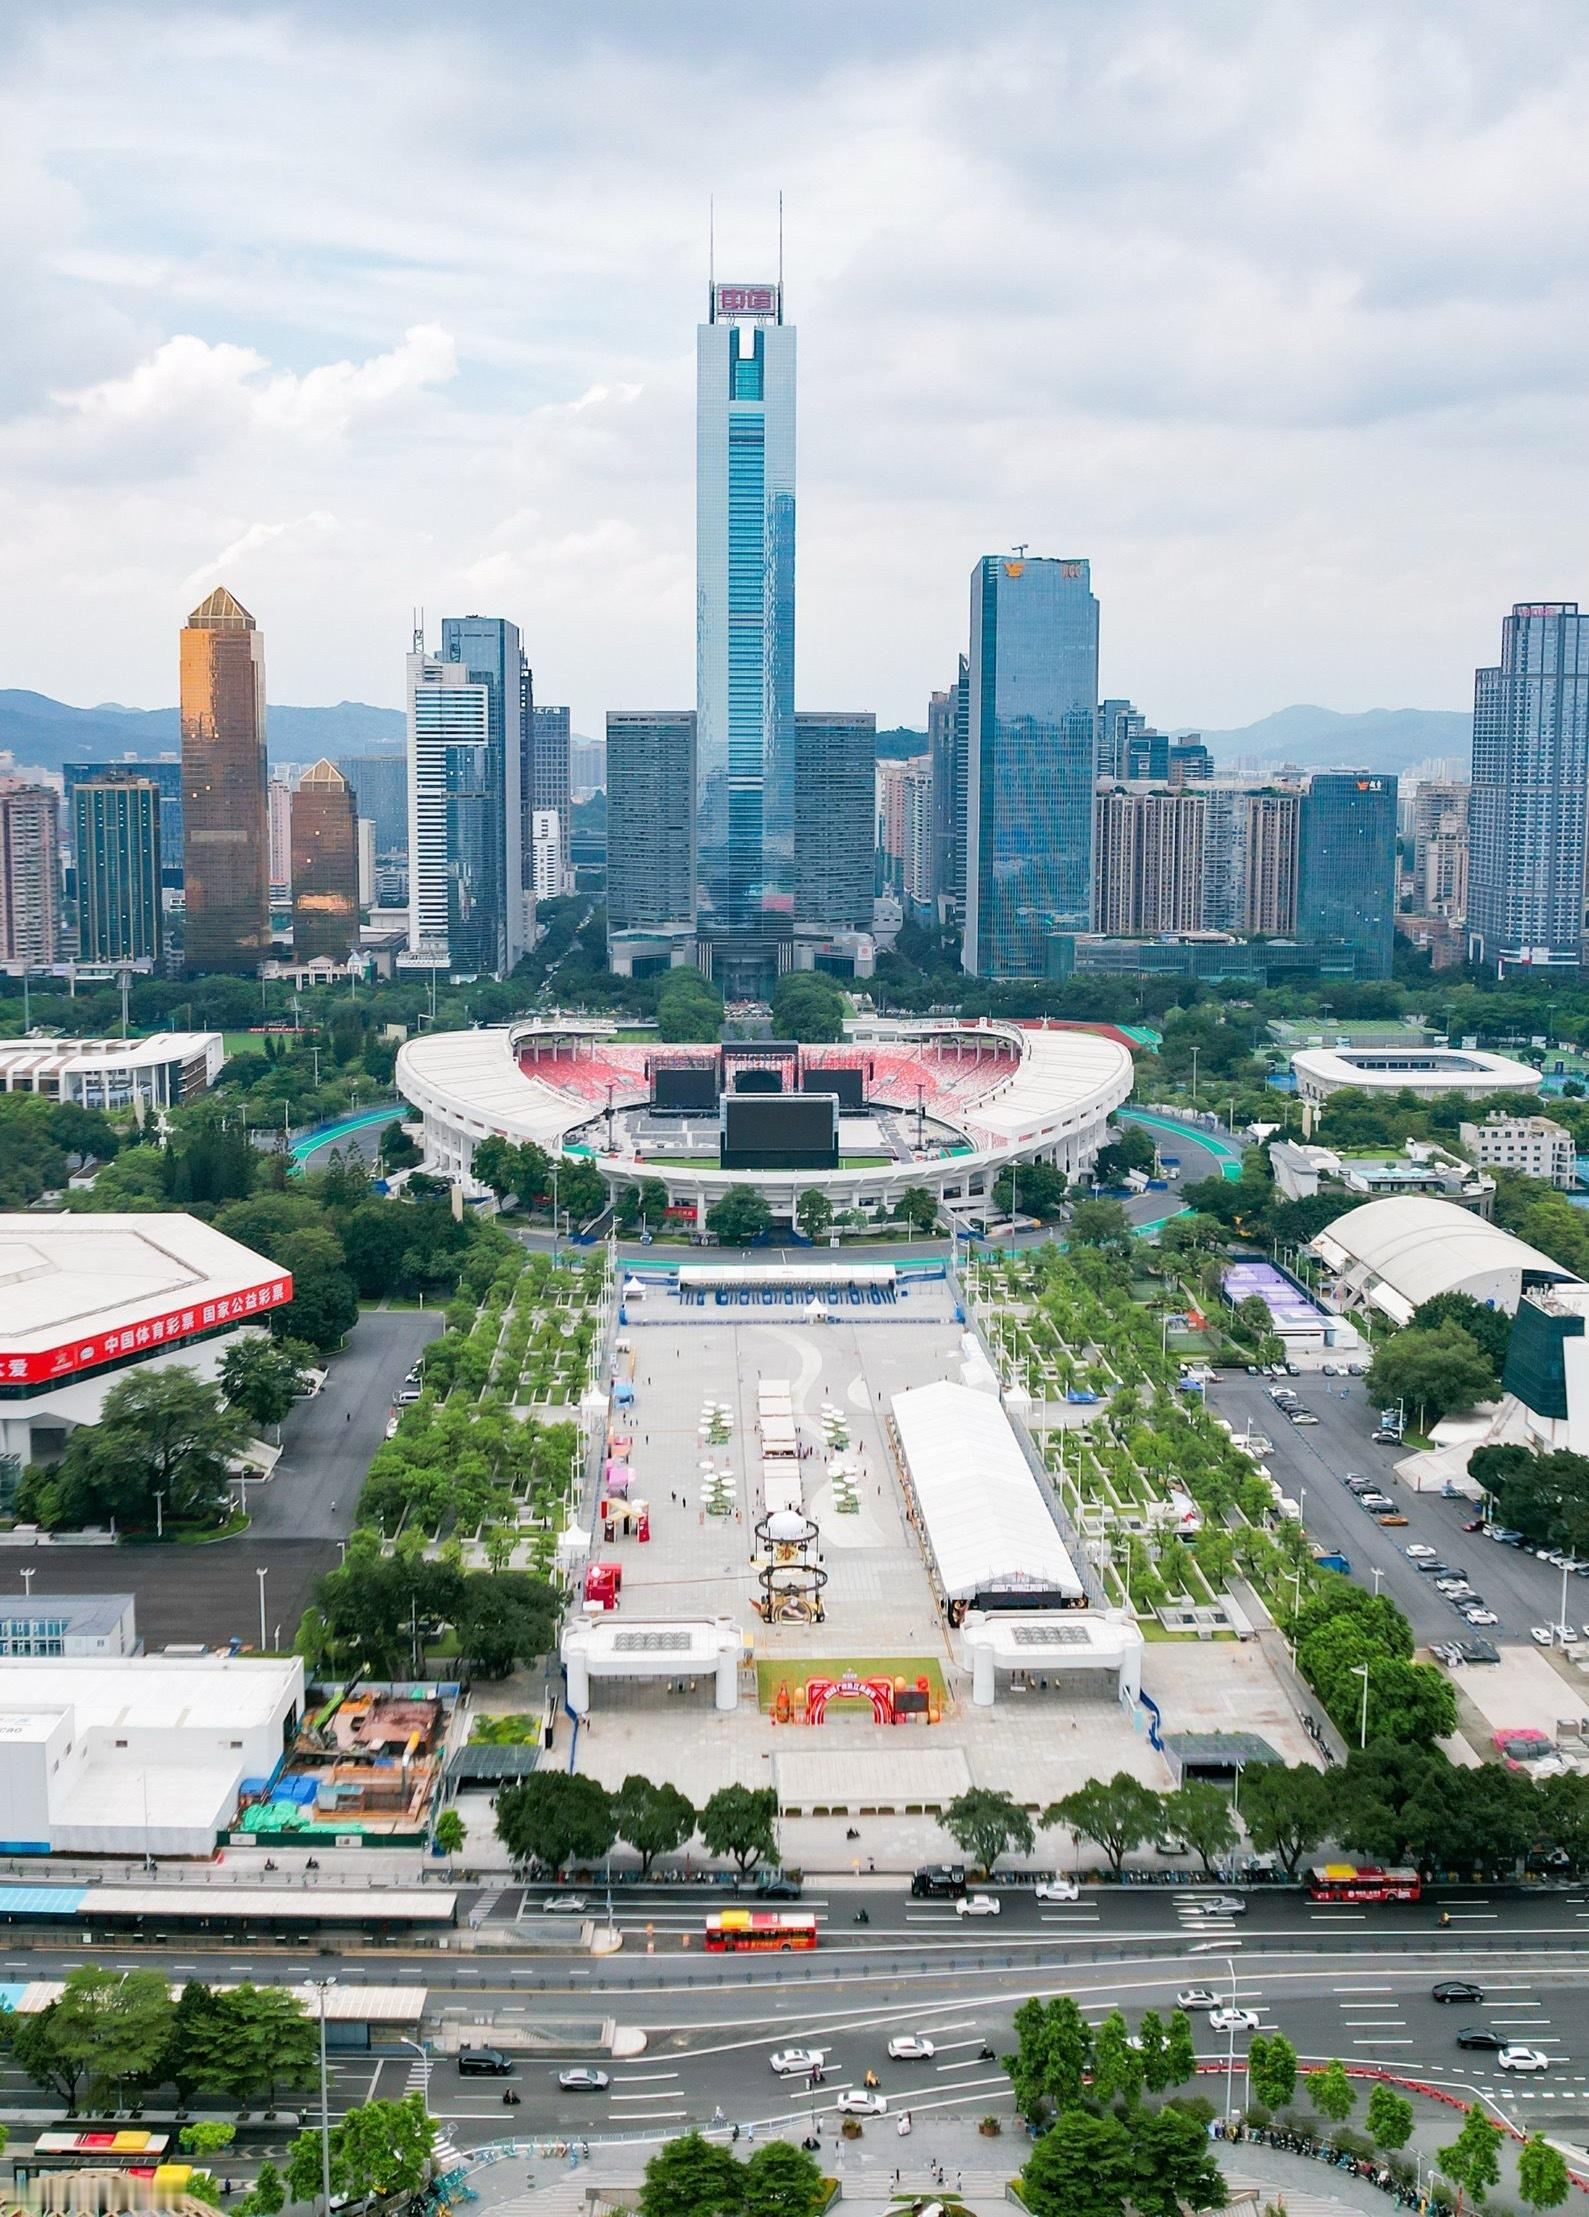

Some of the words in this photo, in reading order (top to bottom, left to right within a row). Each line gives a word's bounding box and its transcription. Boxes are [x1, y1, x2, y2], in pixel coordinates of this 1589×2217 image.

[104, 1312, 194, 1354] 中国体育彩票
[202, 1283, 284, 1325] 国家公益彩票
